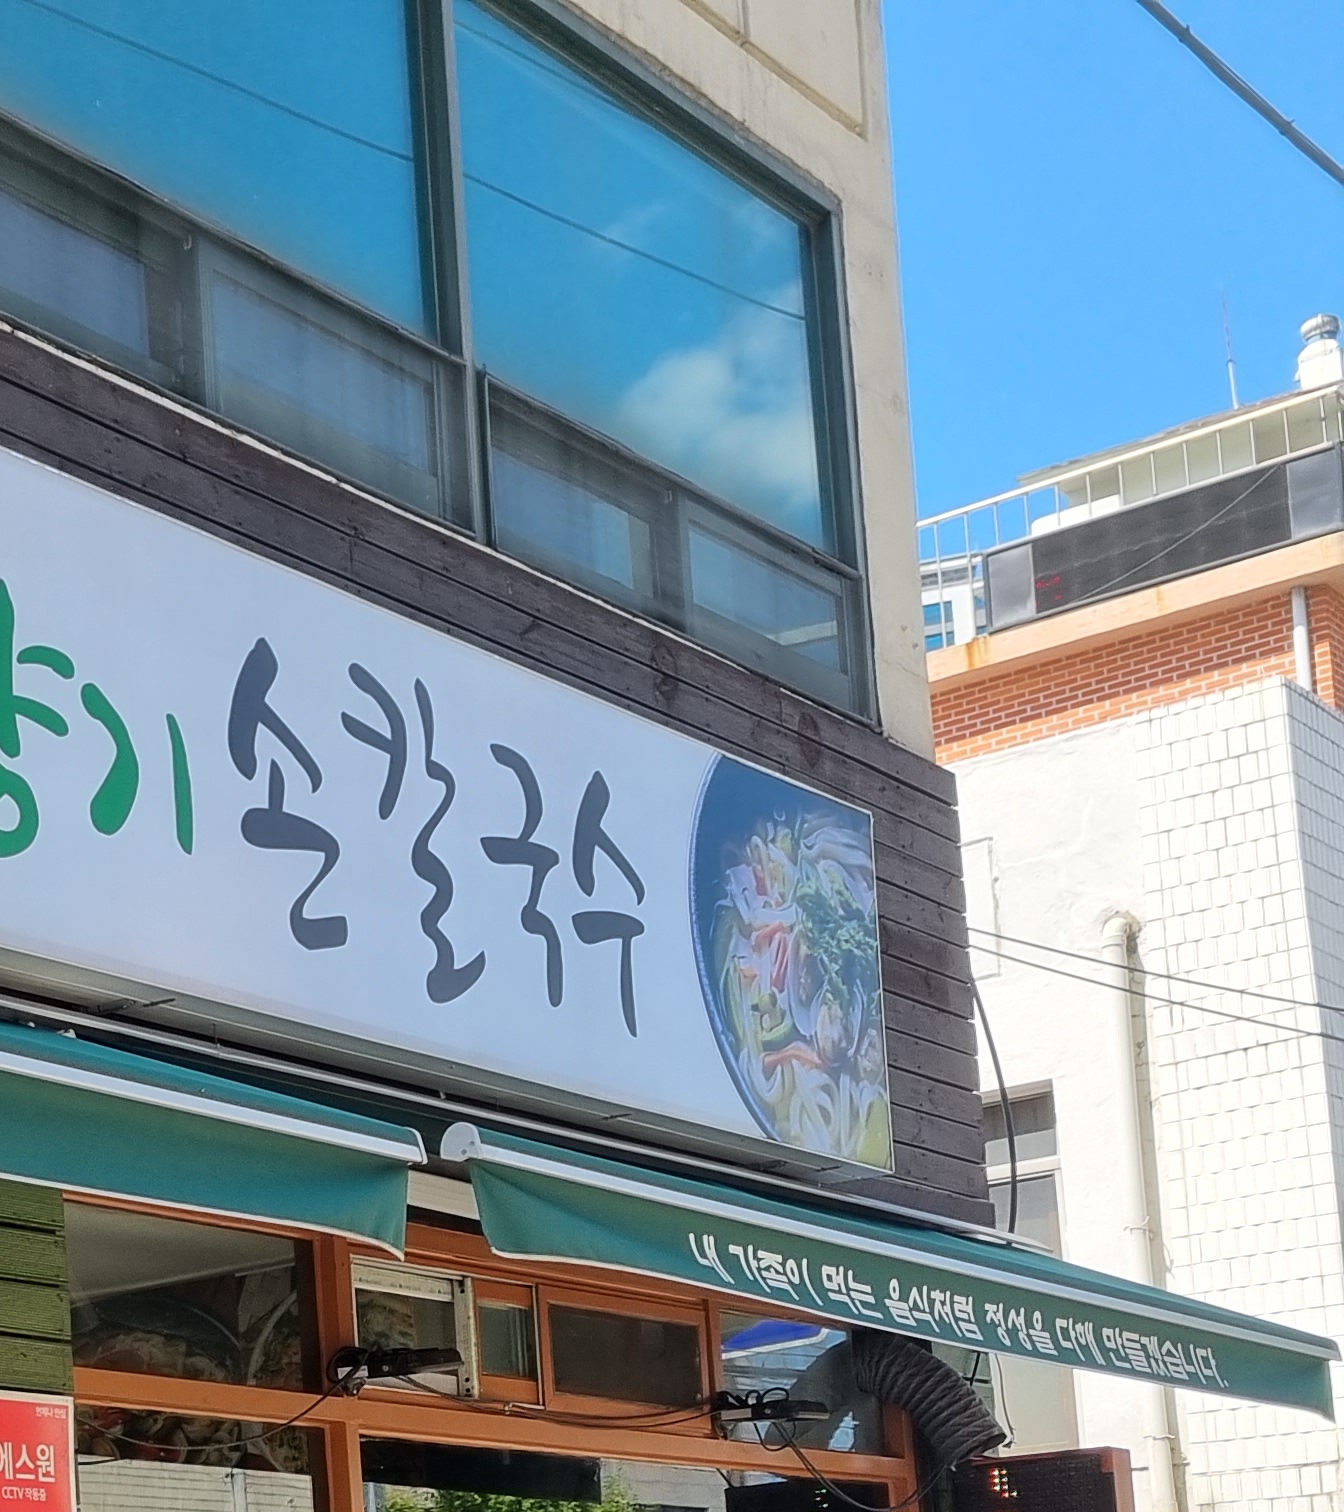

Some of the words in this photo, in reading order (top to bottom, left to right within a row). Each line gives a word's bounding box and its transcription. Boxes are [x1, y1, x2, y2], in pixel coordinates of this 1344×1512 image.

[227, 636, 647, 1038] 손칼국수
[688, 1232, 734, 1284] 내
[729, 1243, 821, 1306] 가족이
[821, 1264, 883, 1319] 먹는
[885, 1278, 985, 1341] 음식처럼
[985, 1301, 1058, 1356] 정성을
[1056, 1317, 1107, 1366] 다해
[1103, 1327, 1230, 1387] 만들겠습니다.
